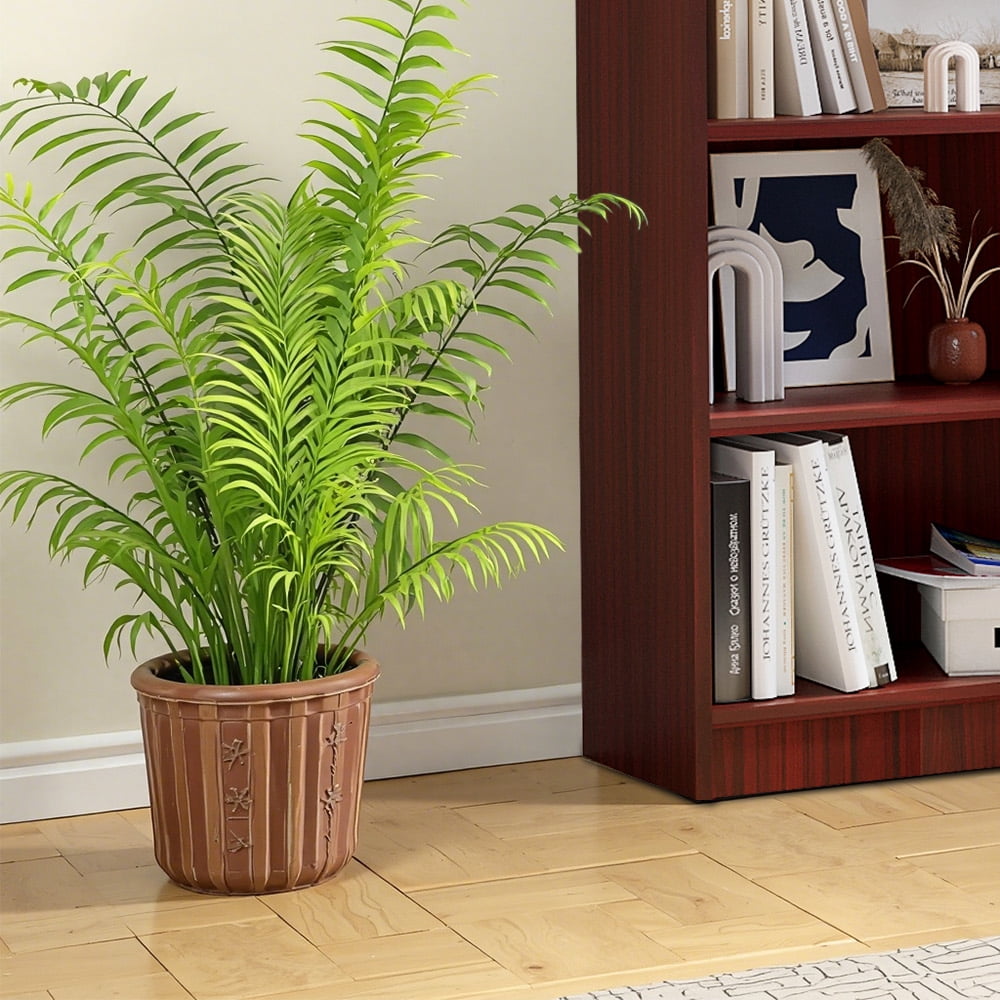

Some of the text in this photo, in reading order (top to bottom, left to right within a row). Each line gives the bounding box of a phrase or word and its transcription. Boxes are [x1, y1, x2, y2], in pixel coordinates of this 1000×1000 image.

[729, 584, 740, 616] Сказки
[760, 466, 772, 661] JOHANNES GRÜTZKE
[829, 553, 856, 652] JOHANNES
